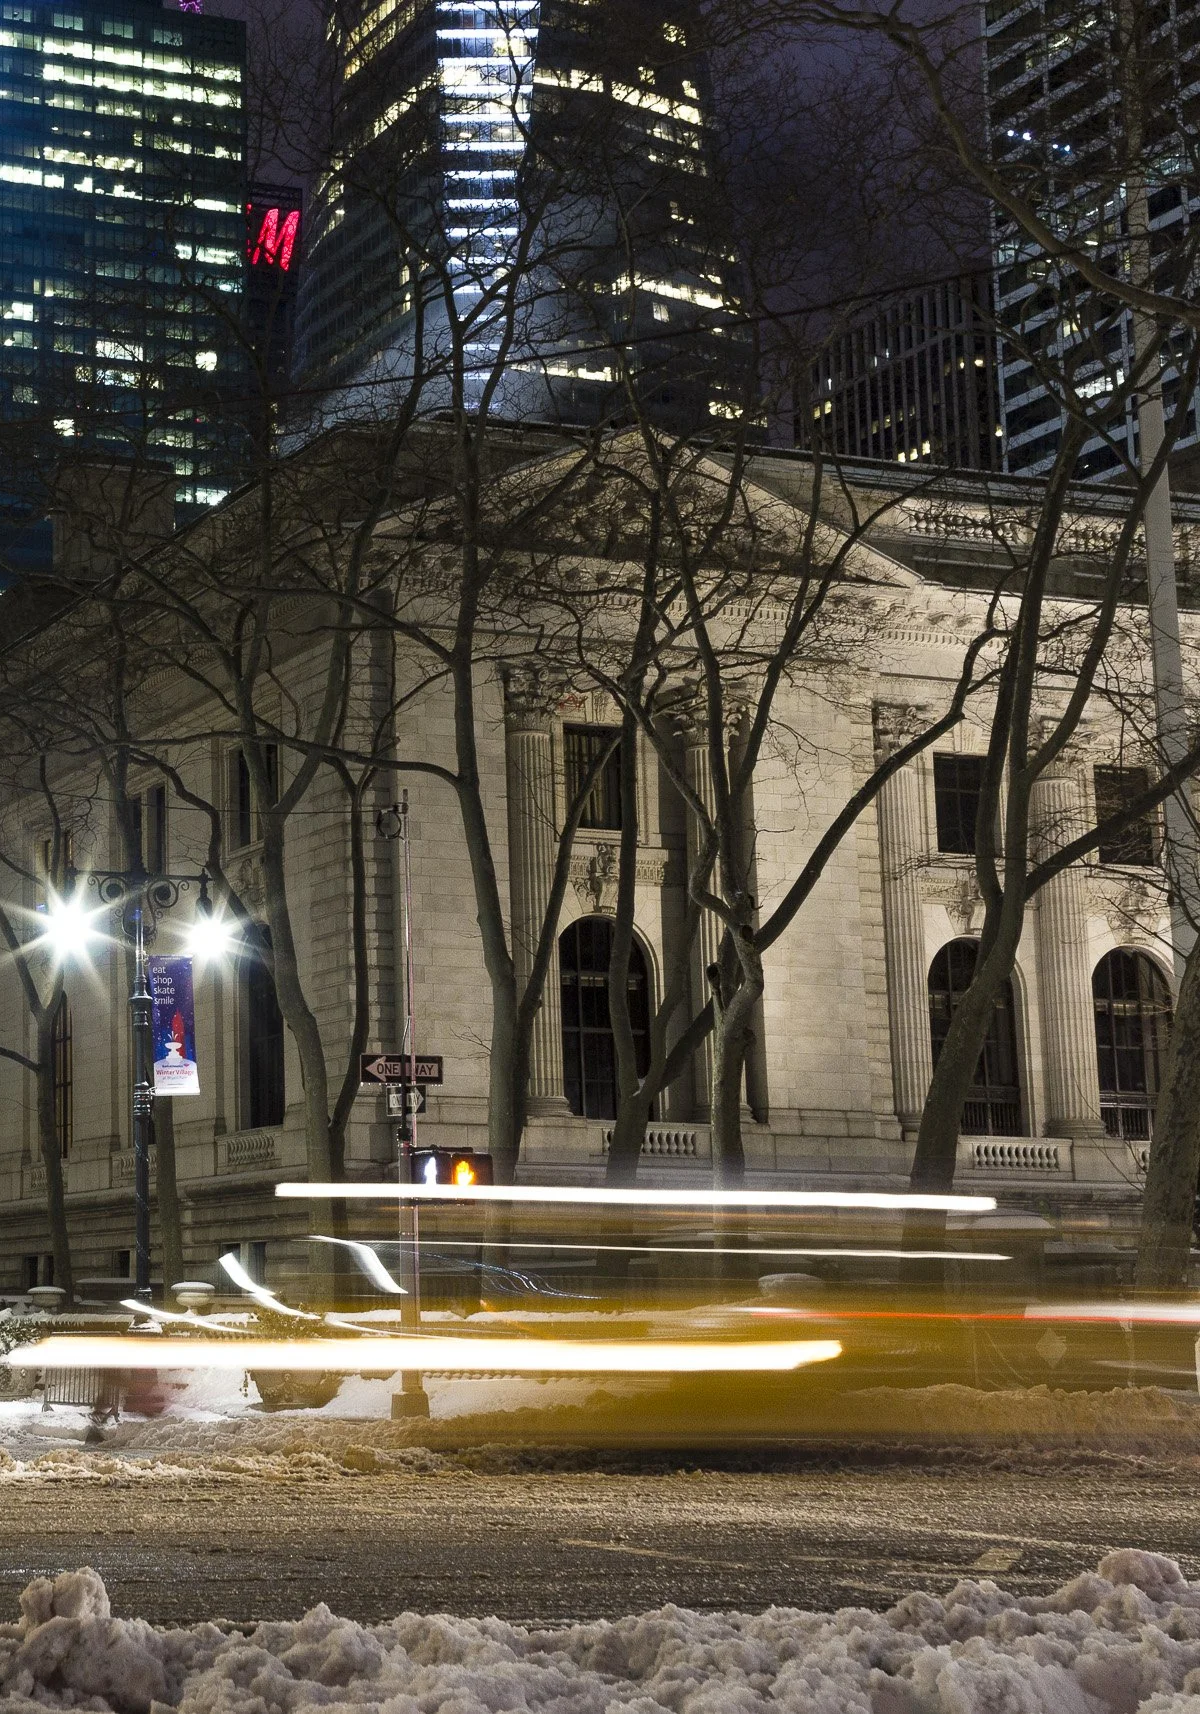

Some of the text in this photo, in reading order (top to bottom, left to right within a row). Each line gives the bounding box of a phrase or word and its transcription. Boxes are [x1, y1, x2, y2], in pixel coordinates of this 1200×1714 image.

[152, 966, 166, 974] eat
[153, 975, 173, 985] shop
[153, 986, 175, 995] skate
[154, 996, 175, 1005] smile
[376, 1063, 399, 1075] ONE
